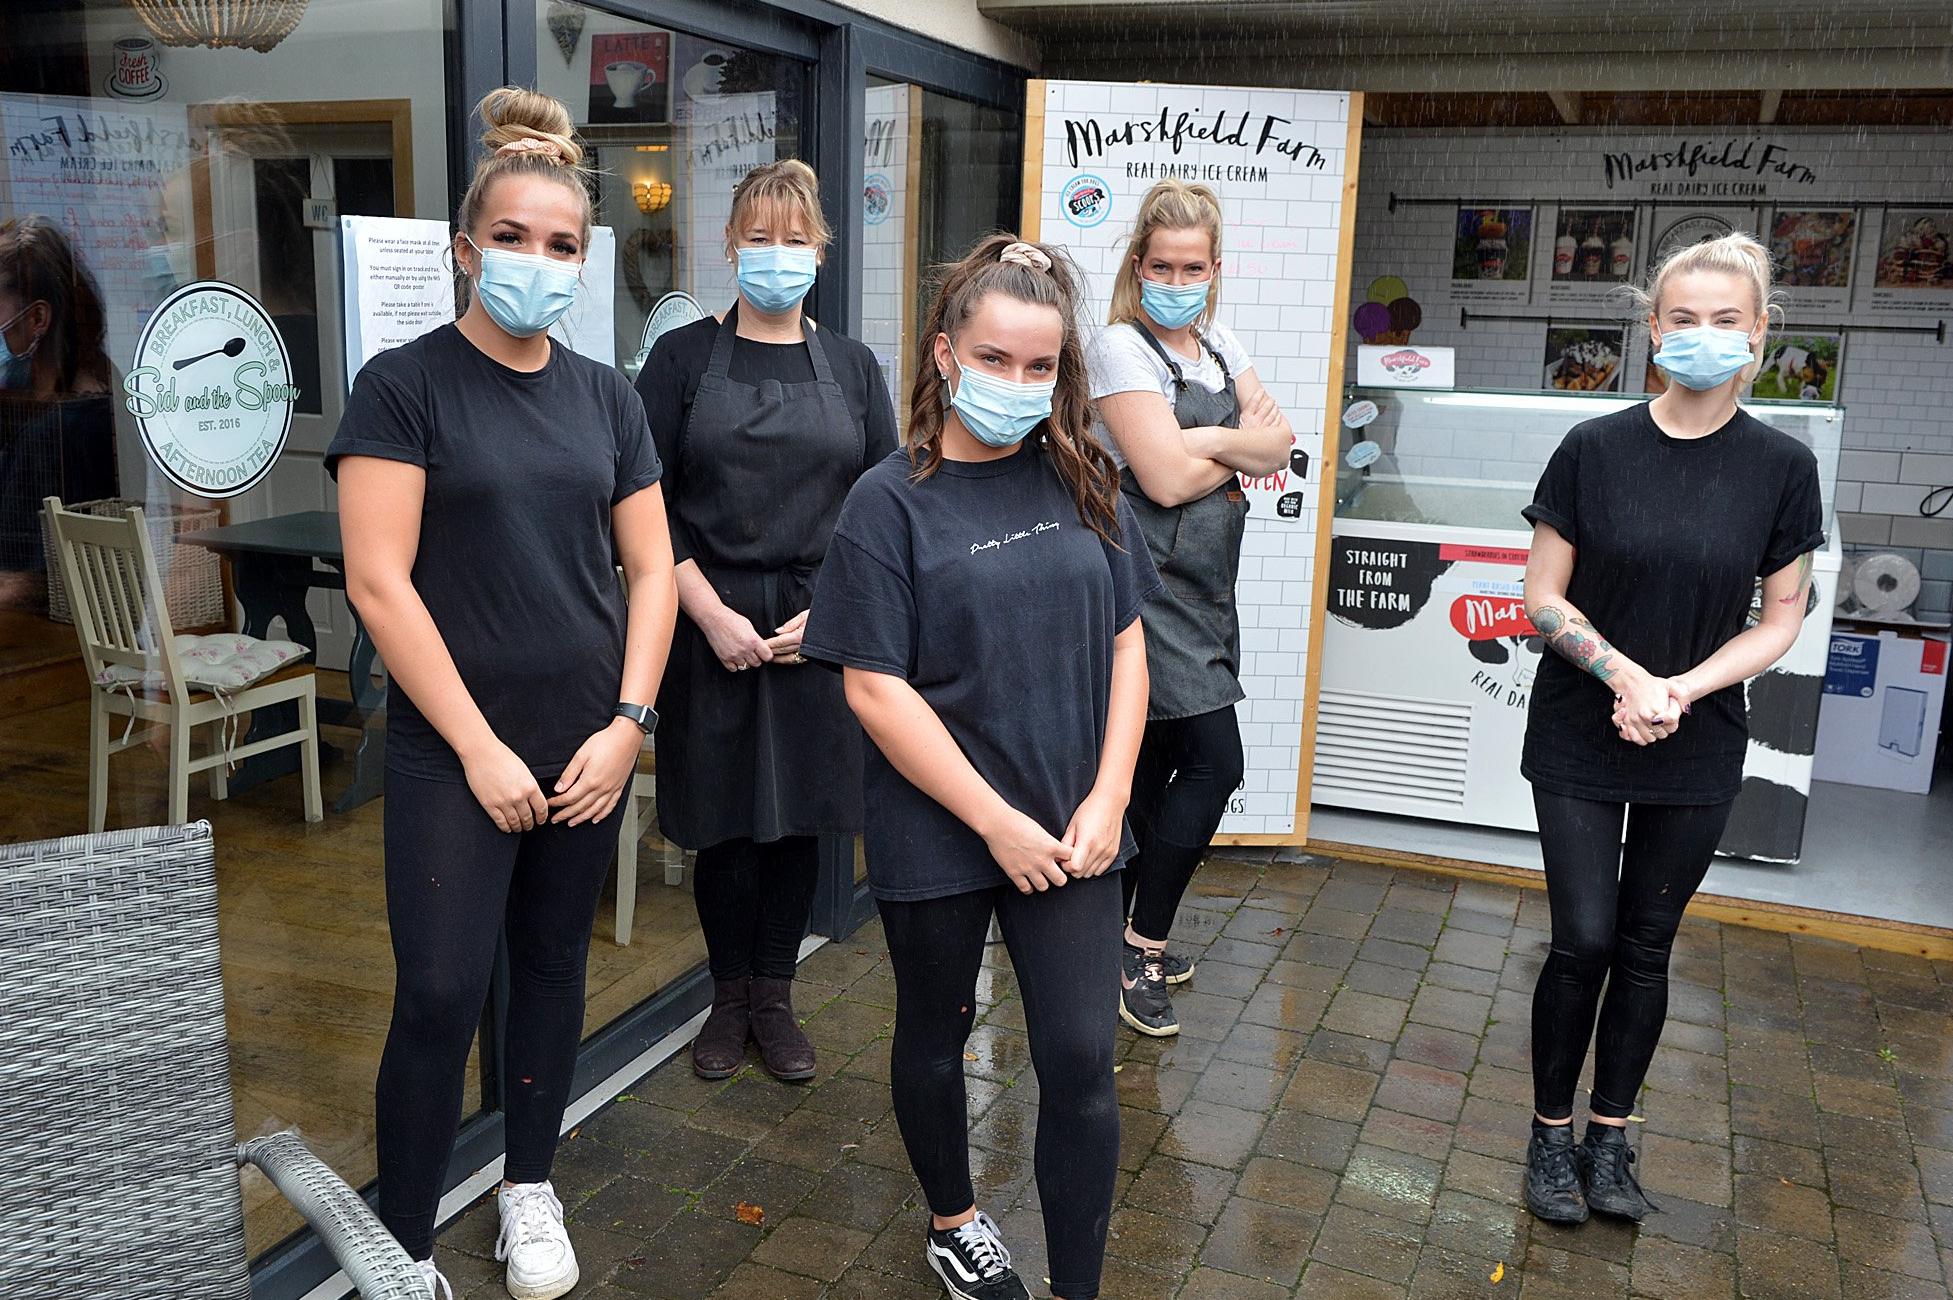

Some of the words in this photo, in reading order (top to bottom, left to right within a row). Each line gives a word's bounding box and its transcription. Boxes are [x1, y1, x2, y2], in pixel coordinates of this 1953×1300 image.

[605, 36, 650, 51] LATTE
[119, 51, 148, 68] Fresh
[118, 66, 150, 85] COFFEE
[1064, 106, 1251, 169] Marshfield
[1255, 114, 1327, 171] Farm
[1126, 161, 1156, 179] REAL
[1160, 162, 1198, 181] DAIRY
[1202, 163, 1222, 182] ICE
[1226, 164, 1268, 183] CREAM
[1603, 140, 1752, 190] Marshfield
[1756, 143, 1817, 186] Farm
[1650, 182, 1674, 197] REAL
[1677, 182, 1709, 197] DAIRY
[1711, 182, 1729, 197] ICE
[1731, 183, 1768, 197] CREAM
[1072, 191, 1101, 212] SCOOPS
[311, 204, 329, 222] WC
[151, 296, 232, 357] BREAKFAST,
[234, 303, 276, 358] LUNCH
[268, 358, 281, 373] &
[122, 365, 180, 419] Sid
[184, 386, 211, 413] and
[210, 385, 232, 411] the
[232, 360, 302, 413] Spoon
[198, 420, 217, 432] EST.
[218, 417, 241, 430] 2016
[159, 440, 249, 486] AFTERNOON
[246, 439, 274, 470] TEA
[1003, 530, 1032, 544] Little
[1031, 521, 1060, 535] Thing
[1345, 549, 1408, 569] STRAIGHT
[1359, 569, 1393, 587] FROM
[1337, 588, 1366, 608] THE
[1370, 590, 1411, 613] FARM
[1832, 643, 1861, 654] TORK
[1470, 670, 1504, 700] REAL
[1507, 690, 1526, 709] DA
[1224, 797, 1245, 814] OGS
